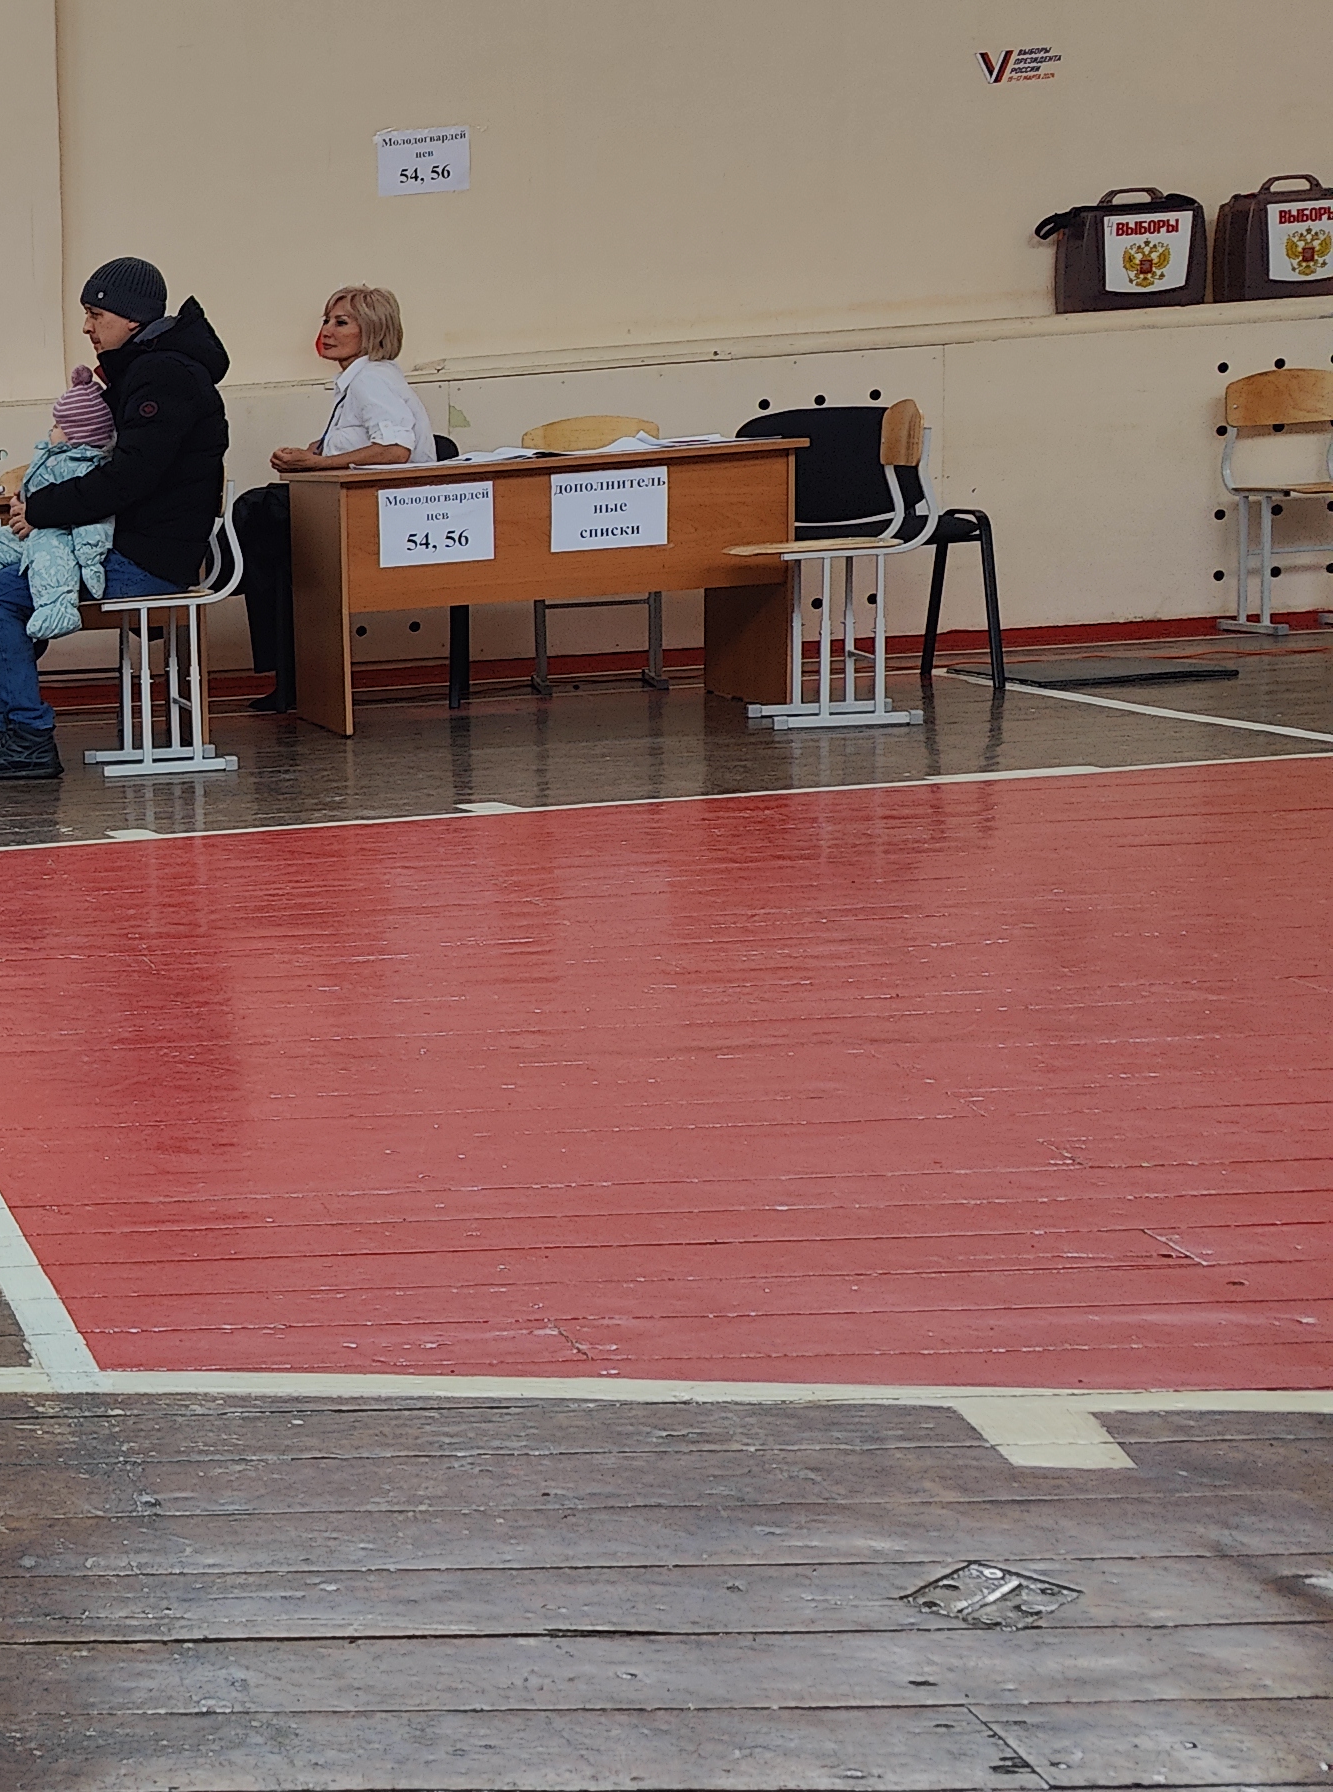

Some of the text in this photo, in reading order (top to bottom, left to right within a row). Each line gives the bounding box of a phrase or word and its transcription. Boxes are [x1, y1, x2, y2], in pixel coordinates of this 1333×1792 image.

[1017, 46, 1052, 56] ВЫБОРЫ
[382, 130, 466, 147] Молодогвардей
[415, 150, 434, 158] цев
[399, 163, 451, 185] 54, 56
[1116, 218, 1180, 237] ВЫБОРЫ
[553, 472, 666, 496] дополнитель
[385, 488, 490, 507] Молодогвардей
[426, 509, 450, 522] цев
[593, 500, 628, 515] ные
[406, 528, 470, 553] 54, 56
[579, 524, 641, 540] списки
